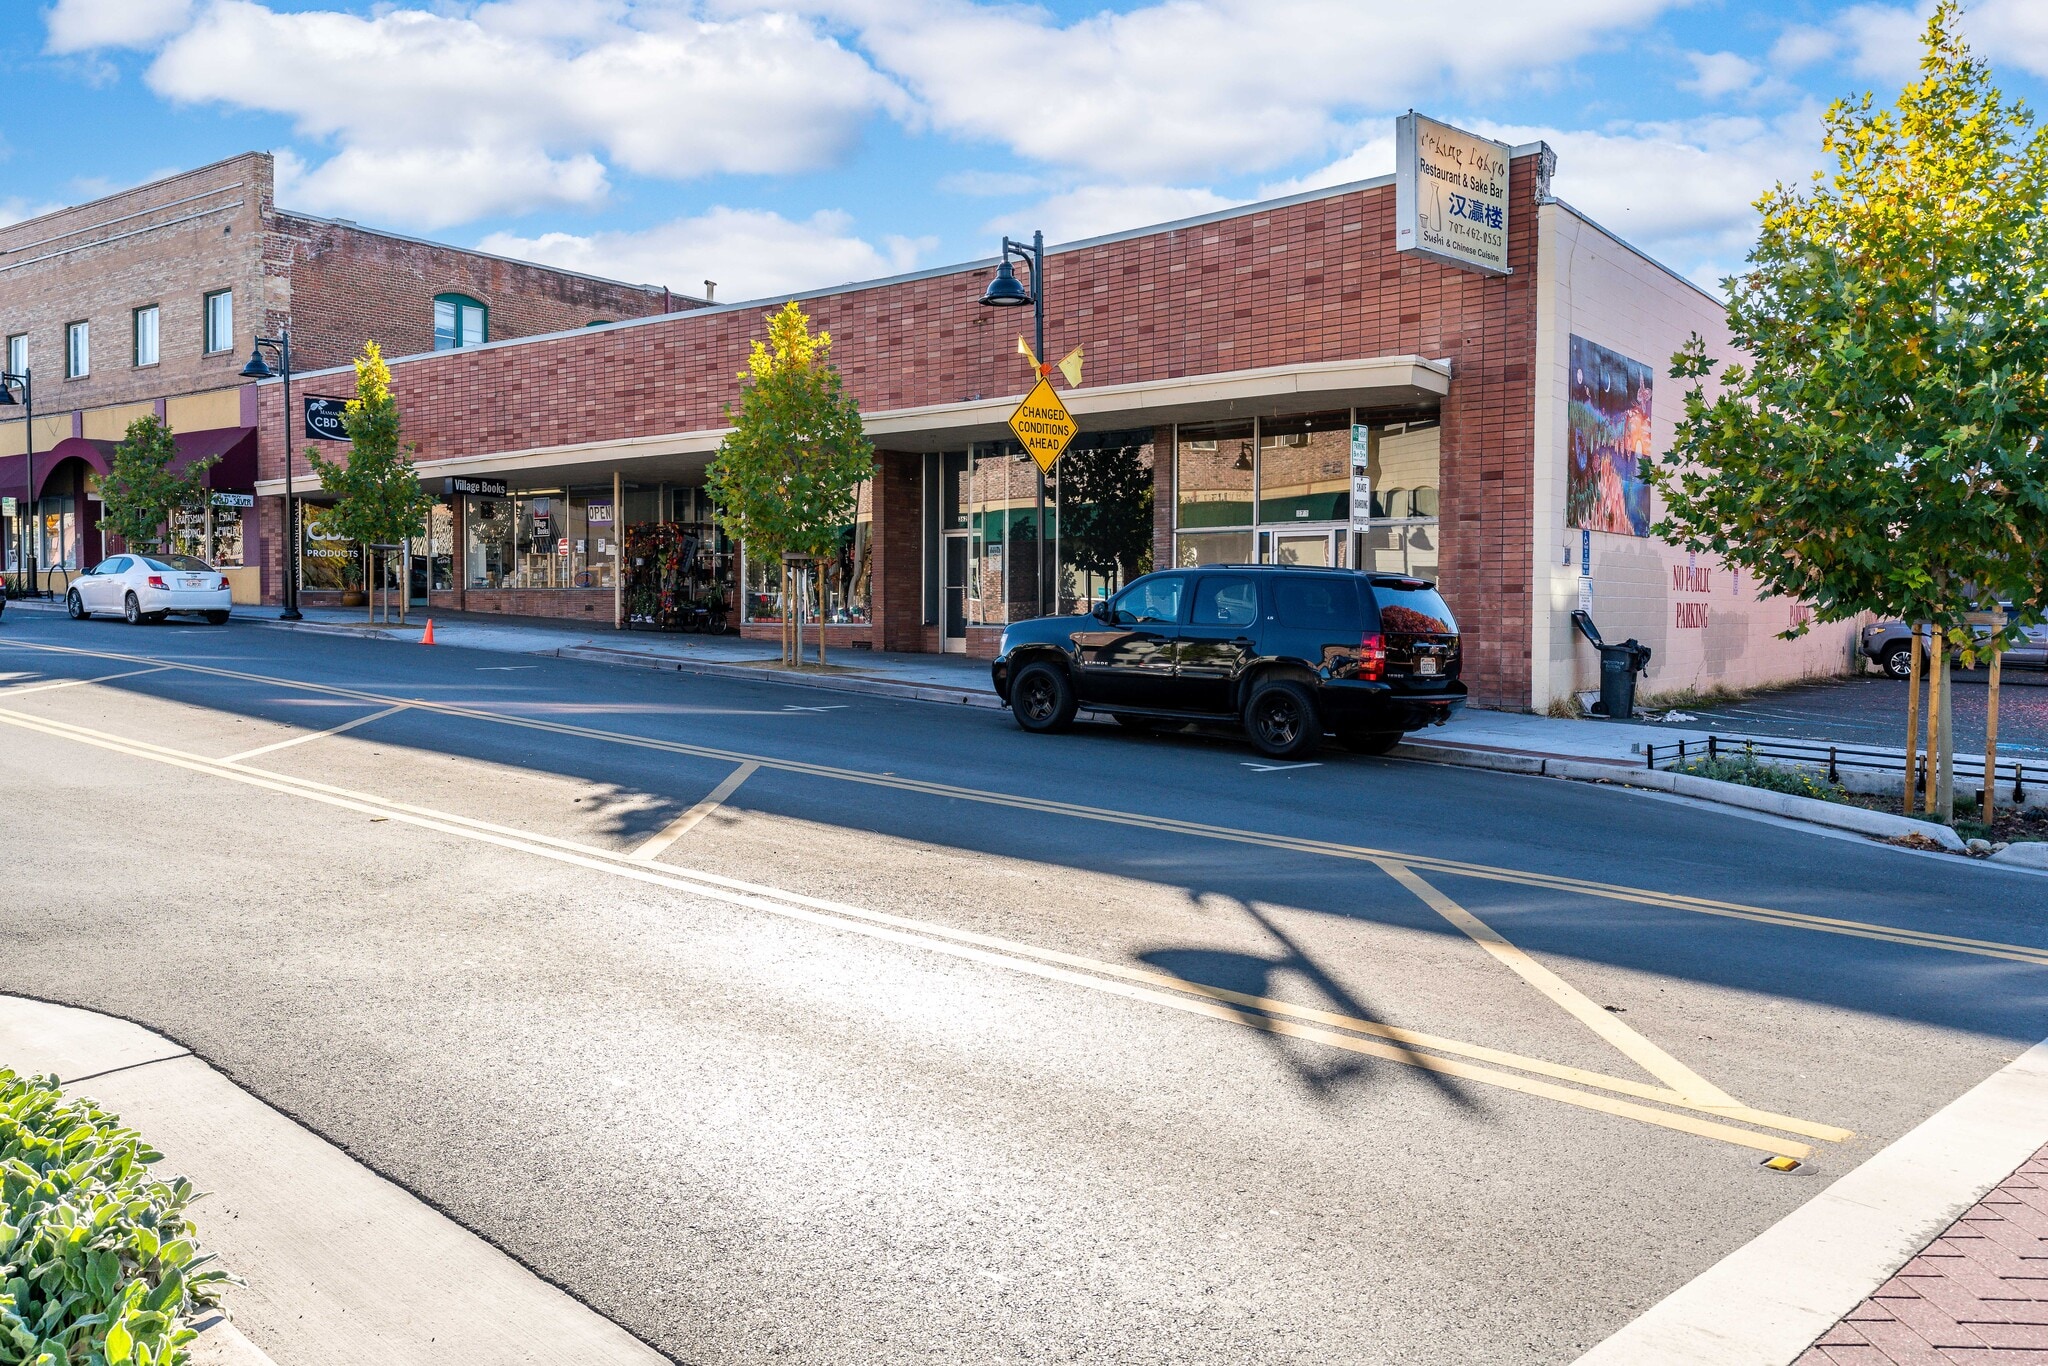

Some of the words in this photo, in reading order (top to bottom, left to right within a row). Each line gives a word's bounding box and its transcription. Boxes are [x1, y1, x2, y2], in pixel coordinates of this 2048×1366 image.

[1420, 158, 1461, 185] Restaurant
[1462, 175, 1468, 188] &
[1470, 176, 1488, 195] Sake
[1490, 180, 1504, 199] Bar
[1448, 192, 1503, 230] 汉瀛楼
[1448, 220, 1502, 247] 707-462-0553
[1423, 230, 1444, 246] Sushi
[1446, 238, 1451, 248] &
[1452, 240, 1477, 255] Chinese
[1478, 248, 1500, 262] Cuisine
[1022, 406, 1065, 420] CHANGED
[314, 416, 338, 428] CBD
[1018, 421, 1069, 436] CONDITIONS
[1029, 437, 1060, 450] AHEAD
[454, 479, 480, 494] Village
[482, 482, 506, 494] Books
[1356, 483, 1367, 493] SKATE
[218, 512, 236, 522] ESTATE
[588, 506, 612, 520] OPEN
[307, 550, 358, 558] PRODUCTS
[1672, 565, 1684, 591] NO
[1686, 567, 1712, 593] PUBLIC
[1676, 602, 1708, 629] PARKING
